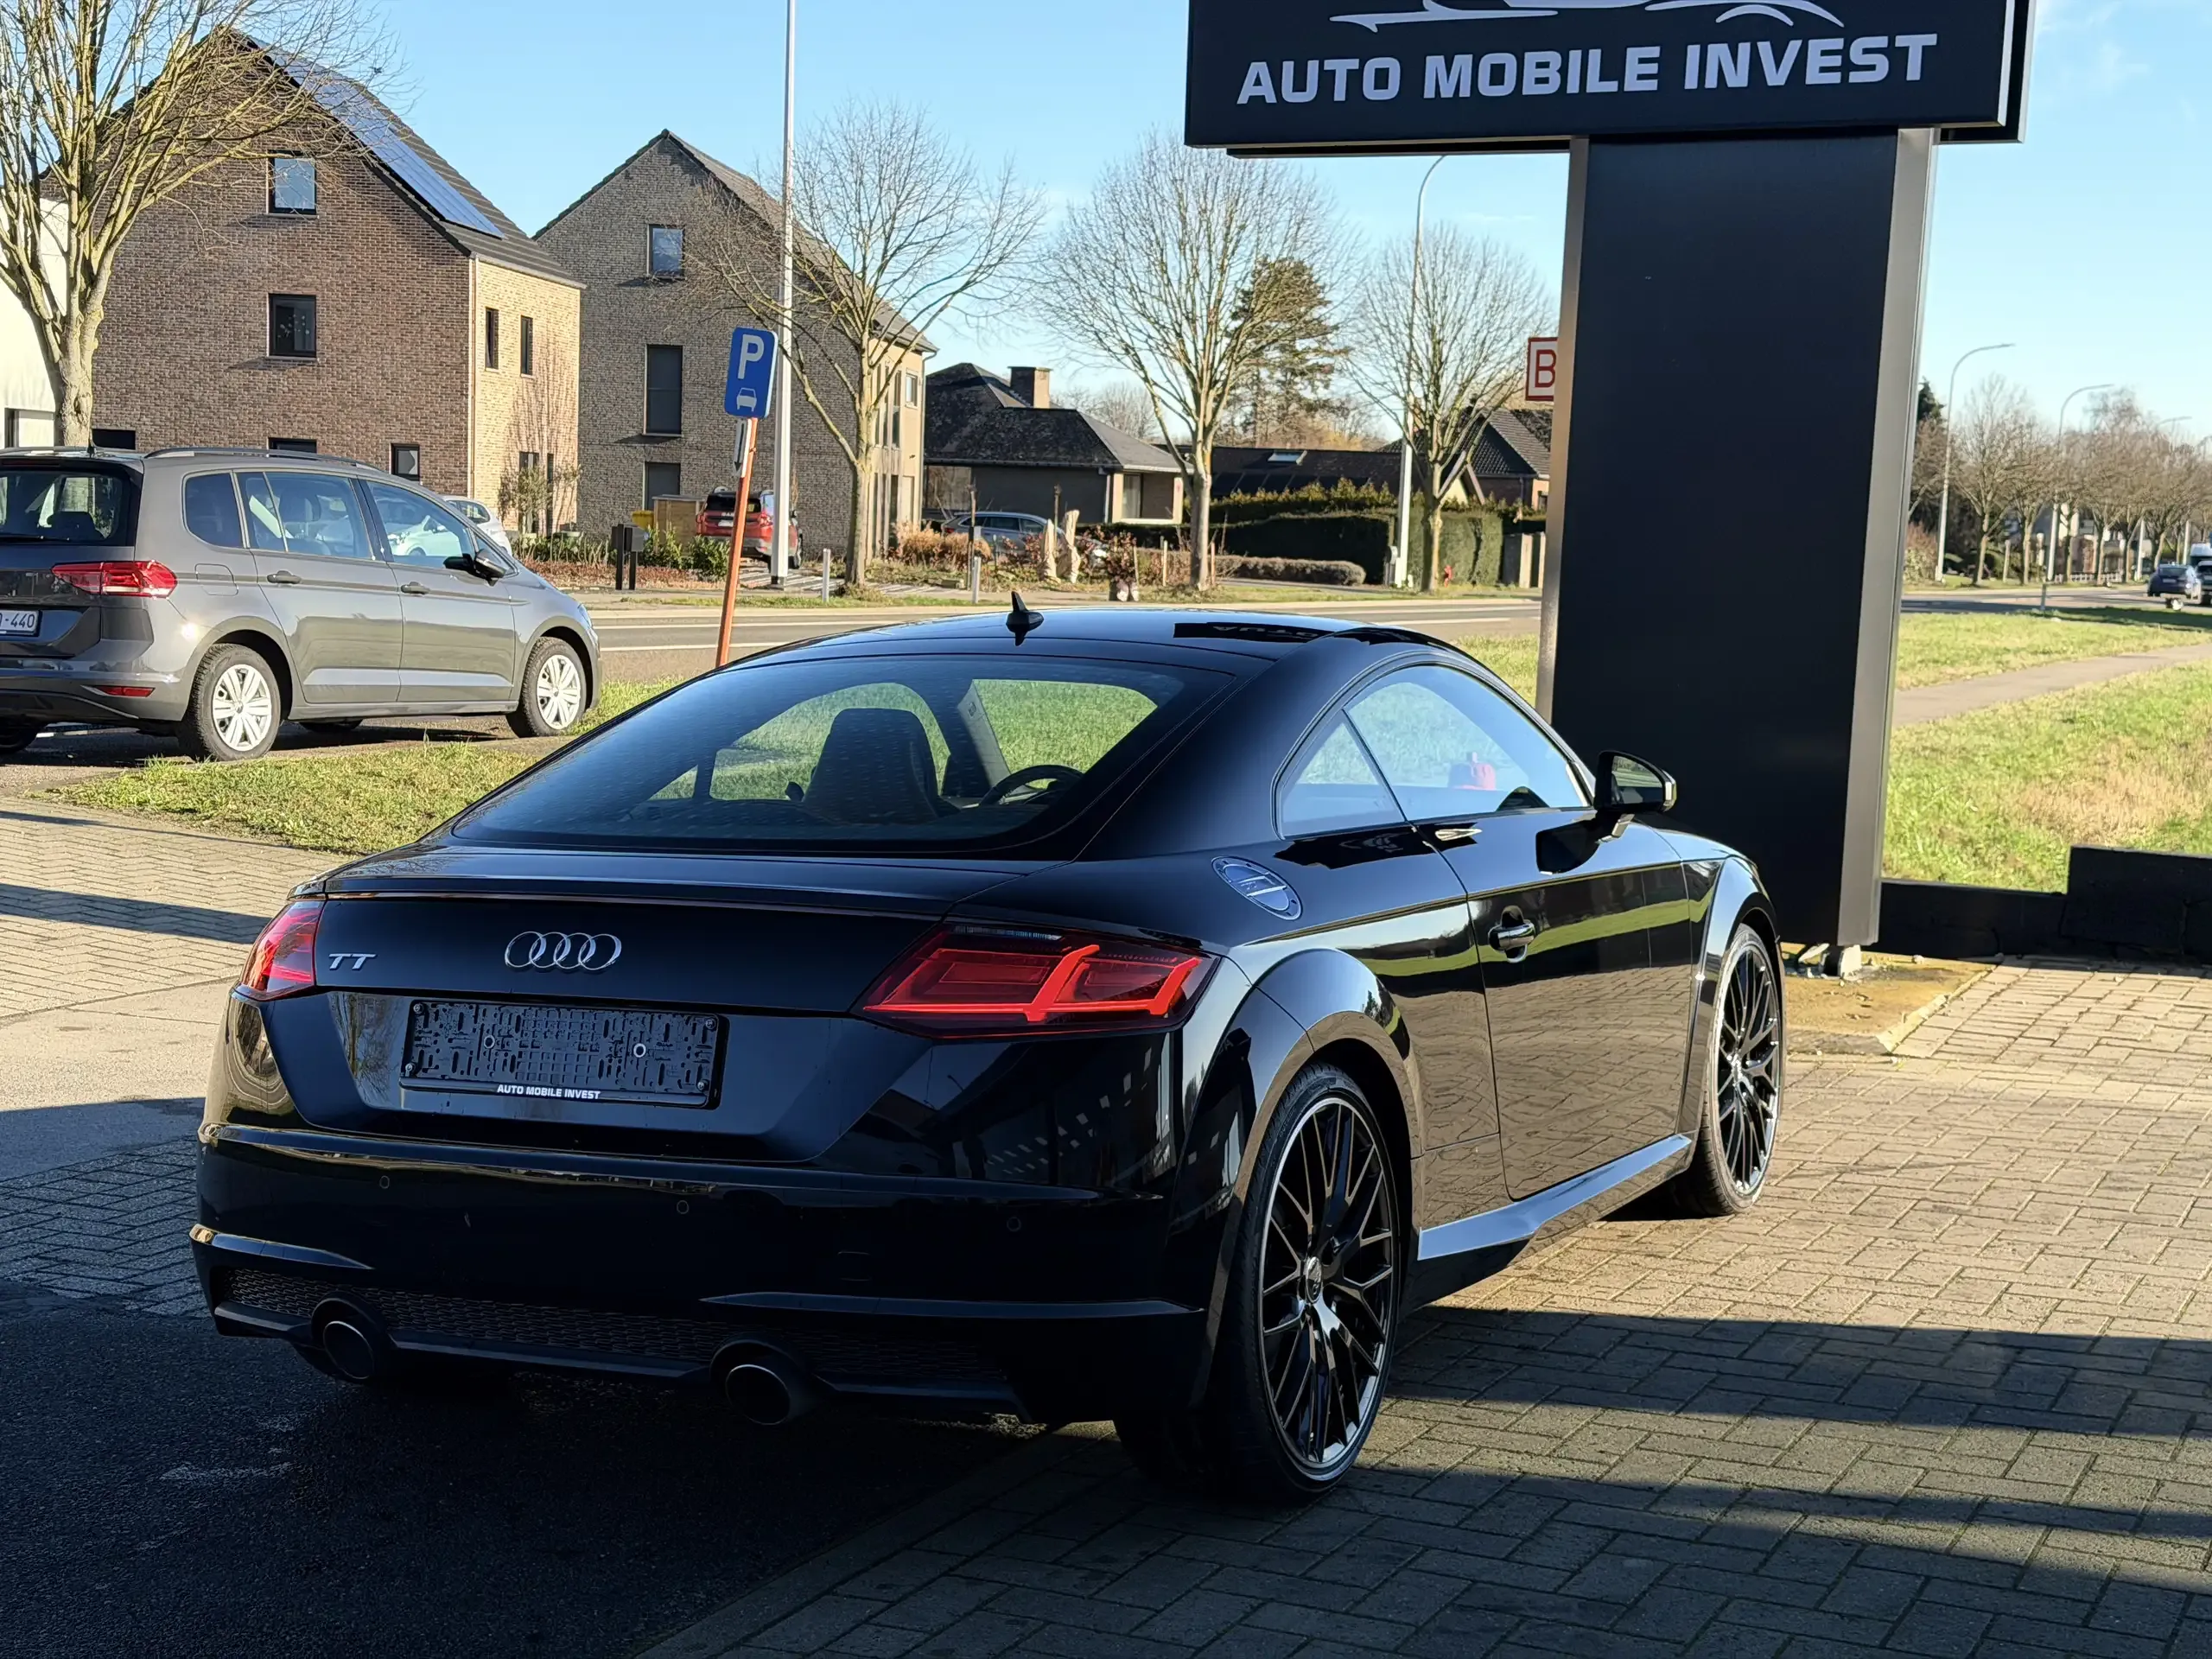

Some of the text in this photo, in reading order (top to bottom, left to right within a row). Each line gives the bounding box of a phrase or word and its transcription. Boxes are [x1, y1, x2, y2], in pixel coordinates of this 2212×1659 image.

[1236, 33, 1938, 105] AUTO MOBILE INVEST
[737, 334, 765, 379] P
[1535, 349, 1557, 388] B
[328, 953, 377, 969] TT
[497, 1084, 601, 1099] AUTO MOBILE INVEST
